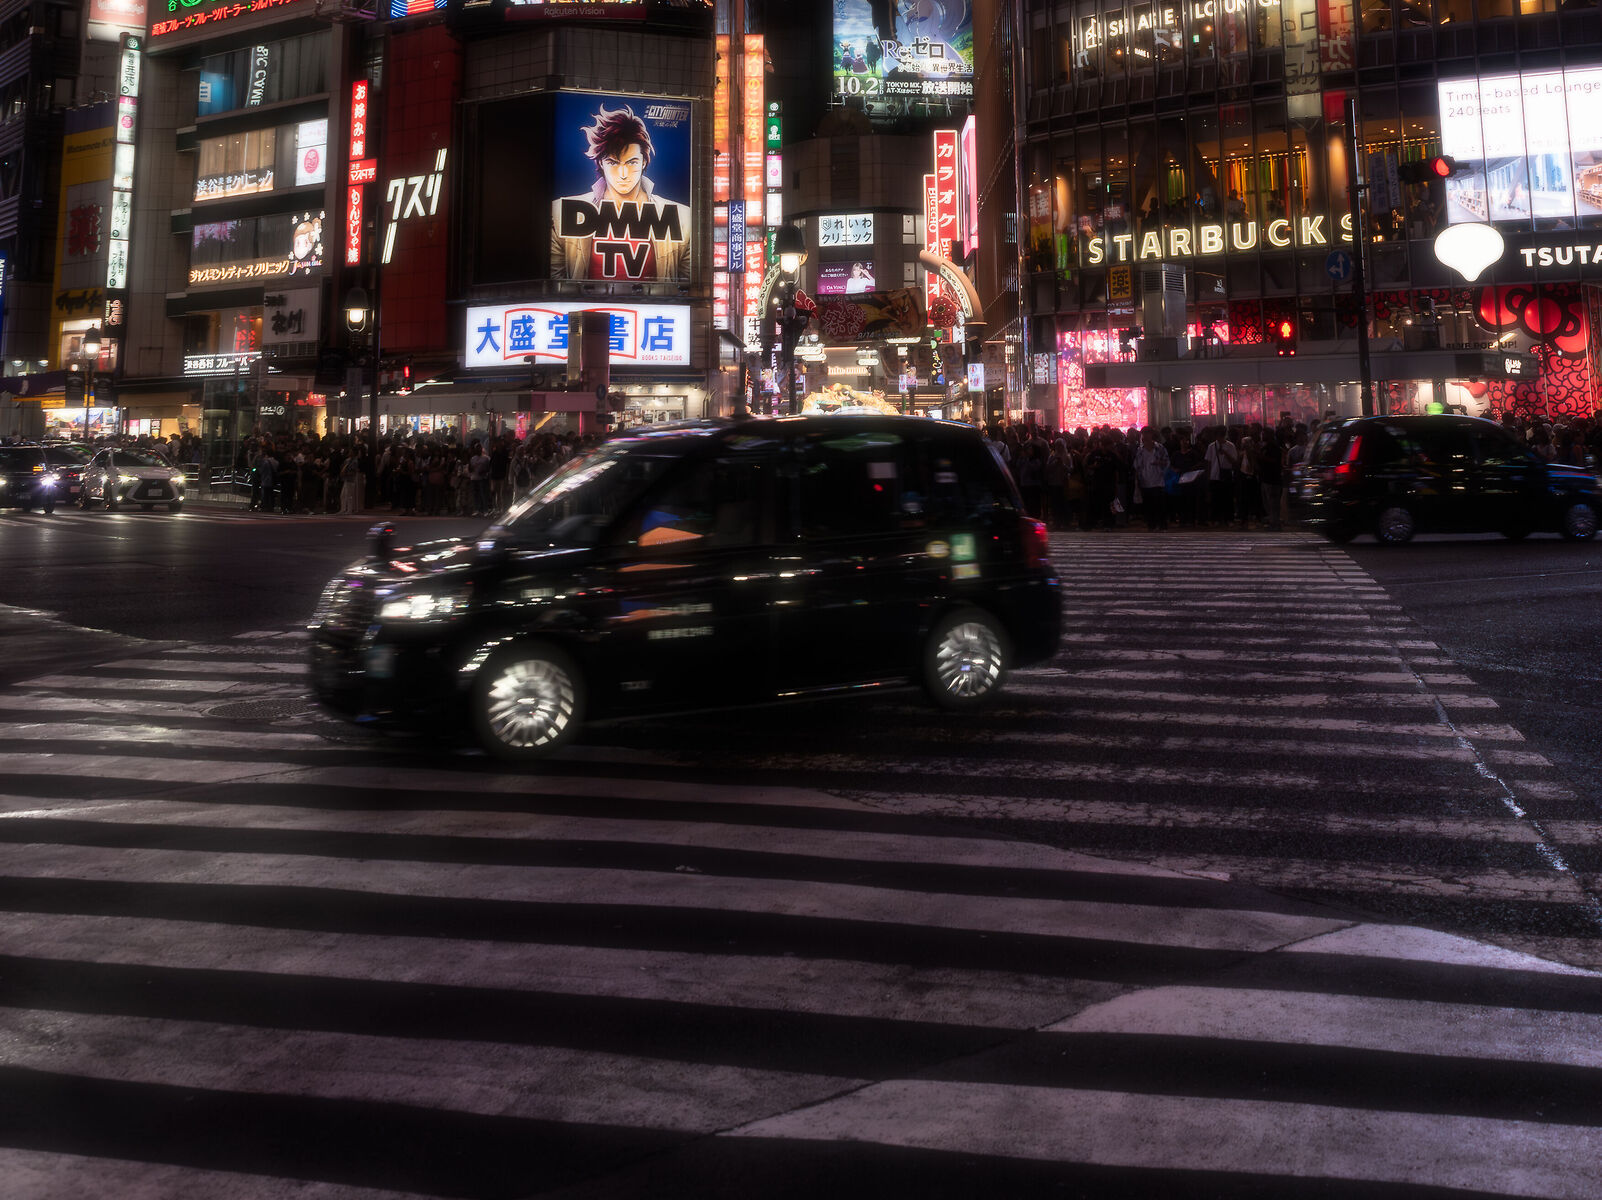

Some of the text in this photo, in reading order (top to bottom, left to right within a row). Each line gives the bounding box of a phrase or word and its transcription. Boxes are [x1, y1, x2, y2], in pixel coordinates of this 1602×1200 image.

[837, 76, 879, 96] 10.2
[921, 81, 973, 96] 放送開始
[886, 81, 909, 89] TOKYO
[648, 105, 665, 117] CITY
[937, 143, 956, 229] カラオケ
[560, 198, 685, 243] DMM
[731, 204, 743, 269] 大盛堂商事ビル
[822, 231, 872, 244] クリニック
[834, 217, 872, 230] れいわ
[1088, 214, 1354, 266] STARBUCKS
[594, 241, 652, 279] TV
[476, 314, 675, 354] 大盛堂書店
